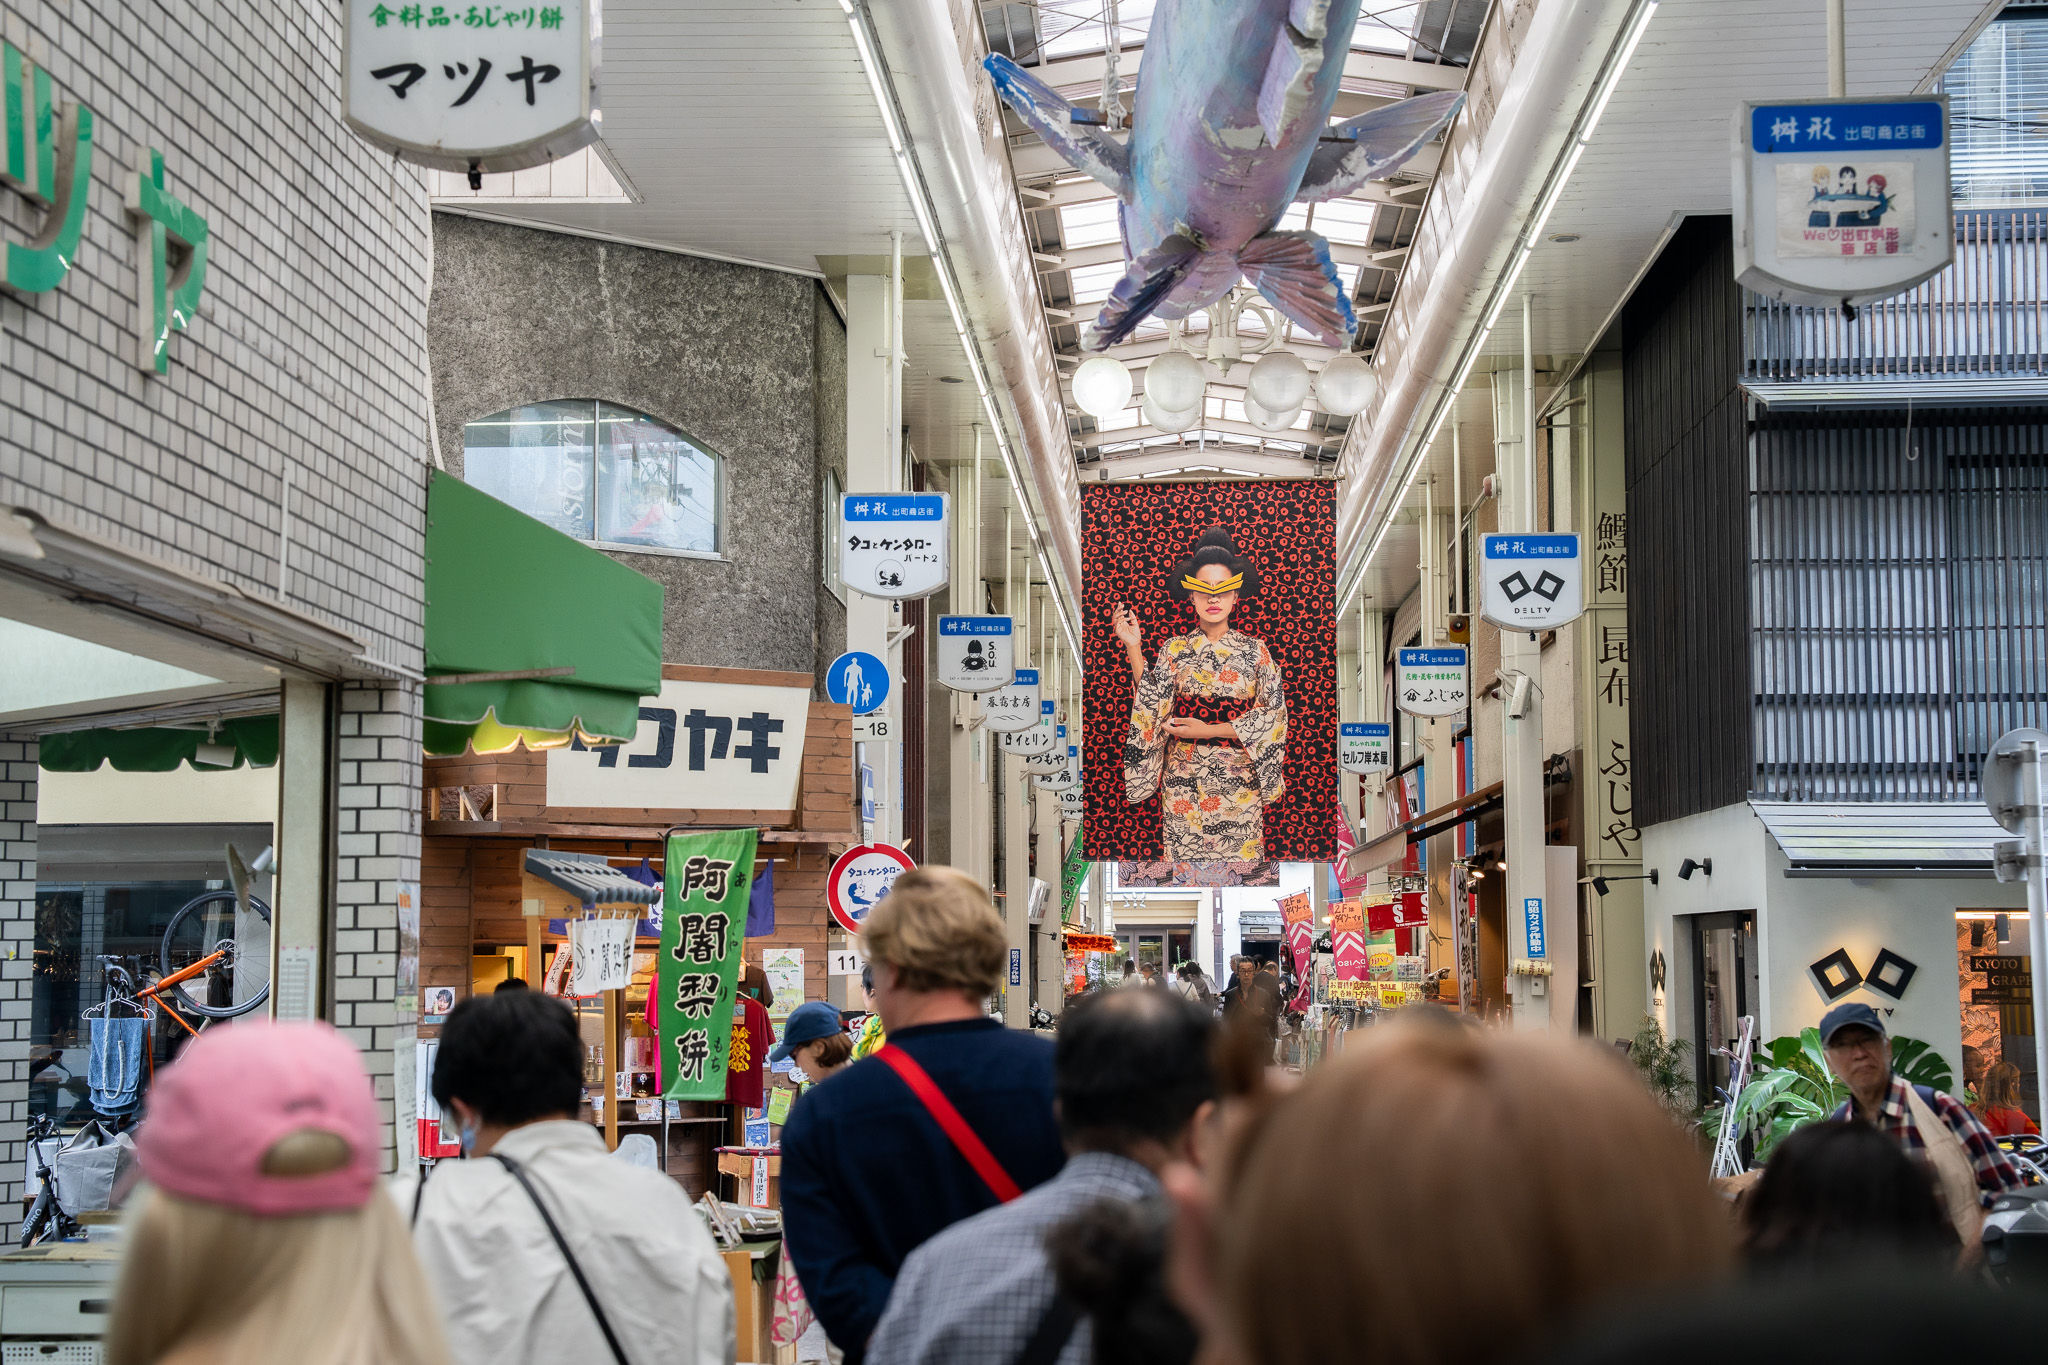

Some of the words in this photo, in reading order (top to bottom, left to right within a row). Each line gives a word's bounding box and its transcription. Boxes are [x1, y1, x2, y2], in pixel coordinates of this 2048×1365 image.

[369, 3, 565, 30] 食料品・あじゃり餅
[370, 55, 562, 108] マツヤ
[1844, 124, 1926, 141] 出町商店街
[1803, 229, 1826, 241] We
[1841, 240, 1900, 256] 商店街
[892, 507, 934, 516] 出町商店街
[847, 535, 932, 551] タコとケンタロー
[1530, 546, 1570, 554] 出町商店街
[1422, 688, 1465, 702] ふじや
[1342, 750, 1389, 765] セルフ岸本屋
[1600, 739, 1642, 858] ふじや
[847, 866, 901, 878] タコとケンタロー
[1527, 900, 1542, 952] 防犯カメラ作動中
[672, 855, 734, 1082] 阿闍梨餅
[1975, 958, 2018, 970] KYOTO
